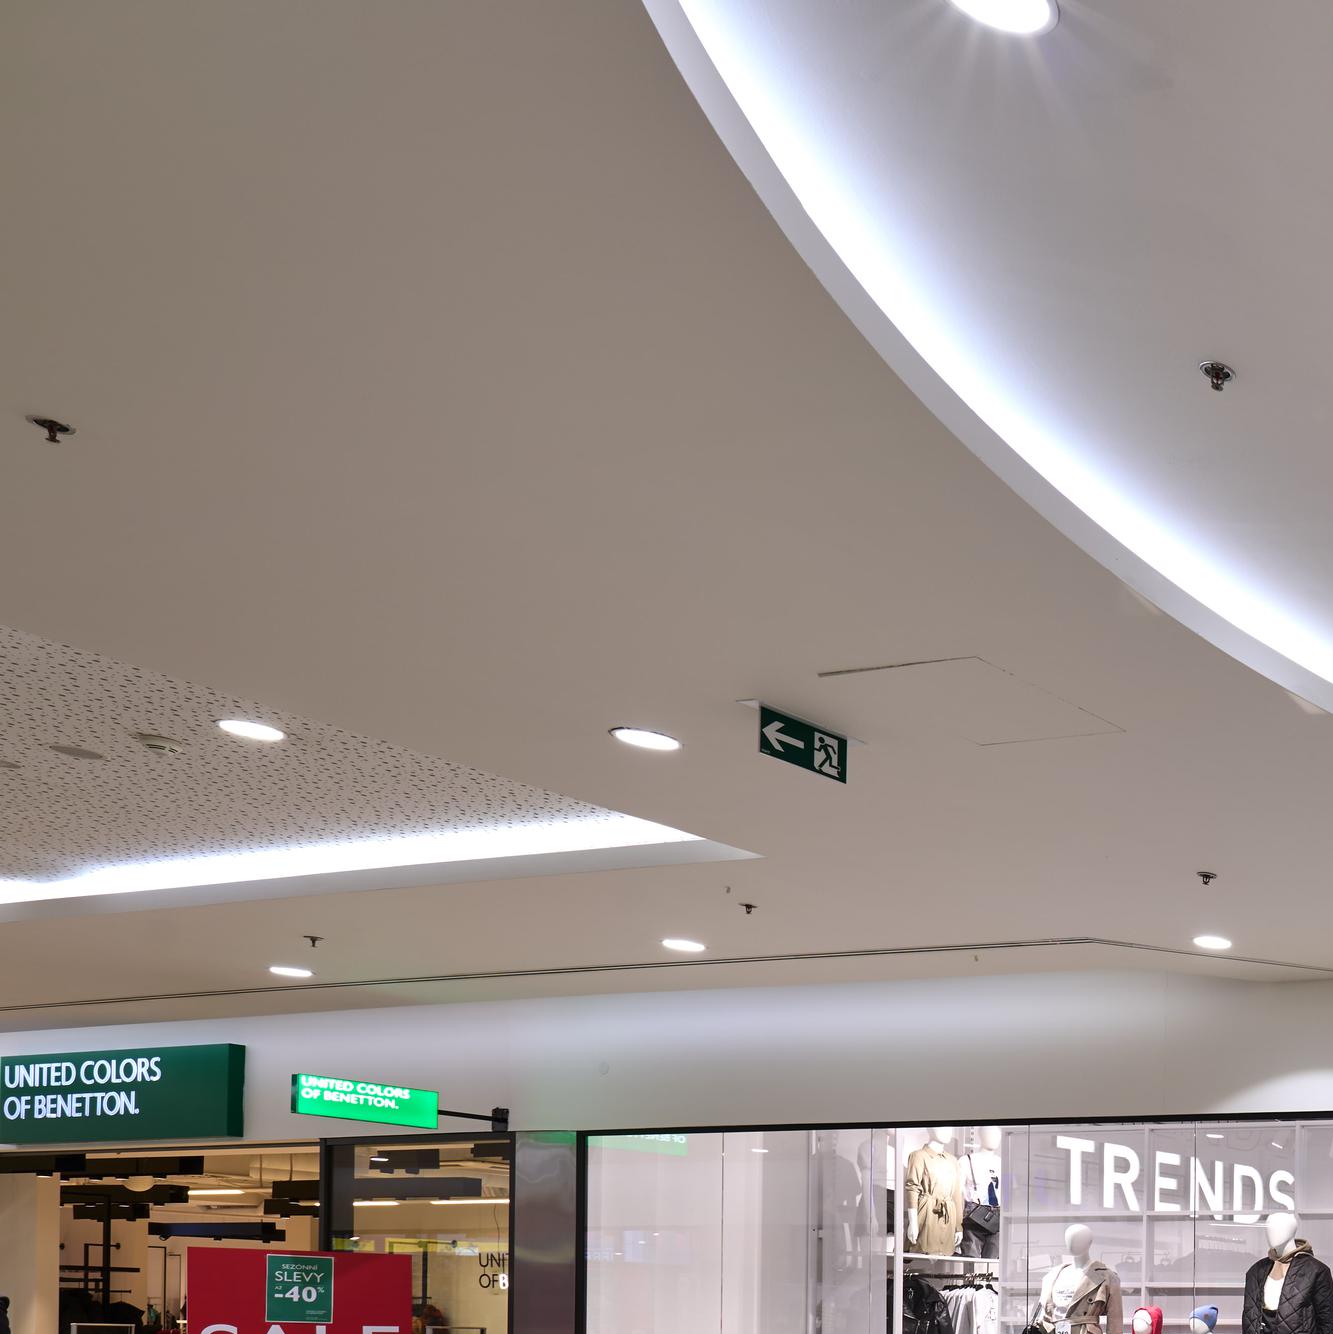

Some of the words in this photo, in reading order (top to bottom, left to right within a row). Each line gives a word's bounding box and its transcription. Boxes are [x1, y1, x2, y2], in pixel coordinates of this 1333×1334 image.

[4, 1062, 76, 1089] UNITED
[80, 1057, 162, 1085] COLORS
[301, 1075, 354, 1092] UNITED
[356, 1083, 410, 1100] COLORS
[301, 1087, 321, 1100] OF
[323, 1090, 399, 1109] BENETTON.
[3, 1096, 31, 1120] OF
[34, 1090, 140, 1119] BENETTON.
[1056, 1135, 1296, 1224] TRENDS
[274, 1271, 325, 1283] SLEVY
